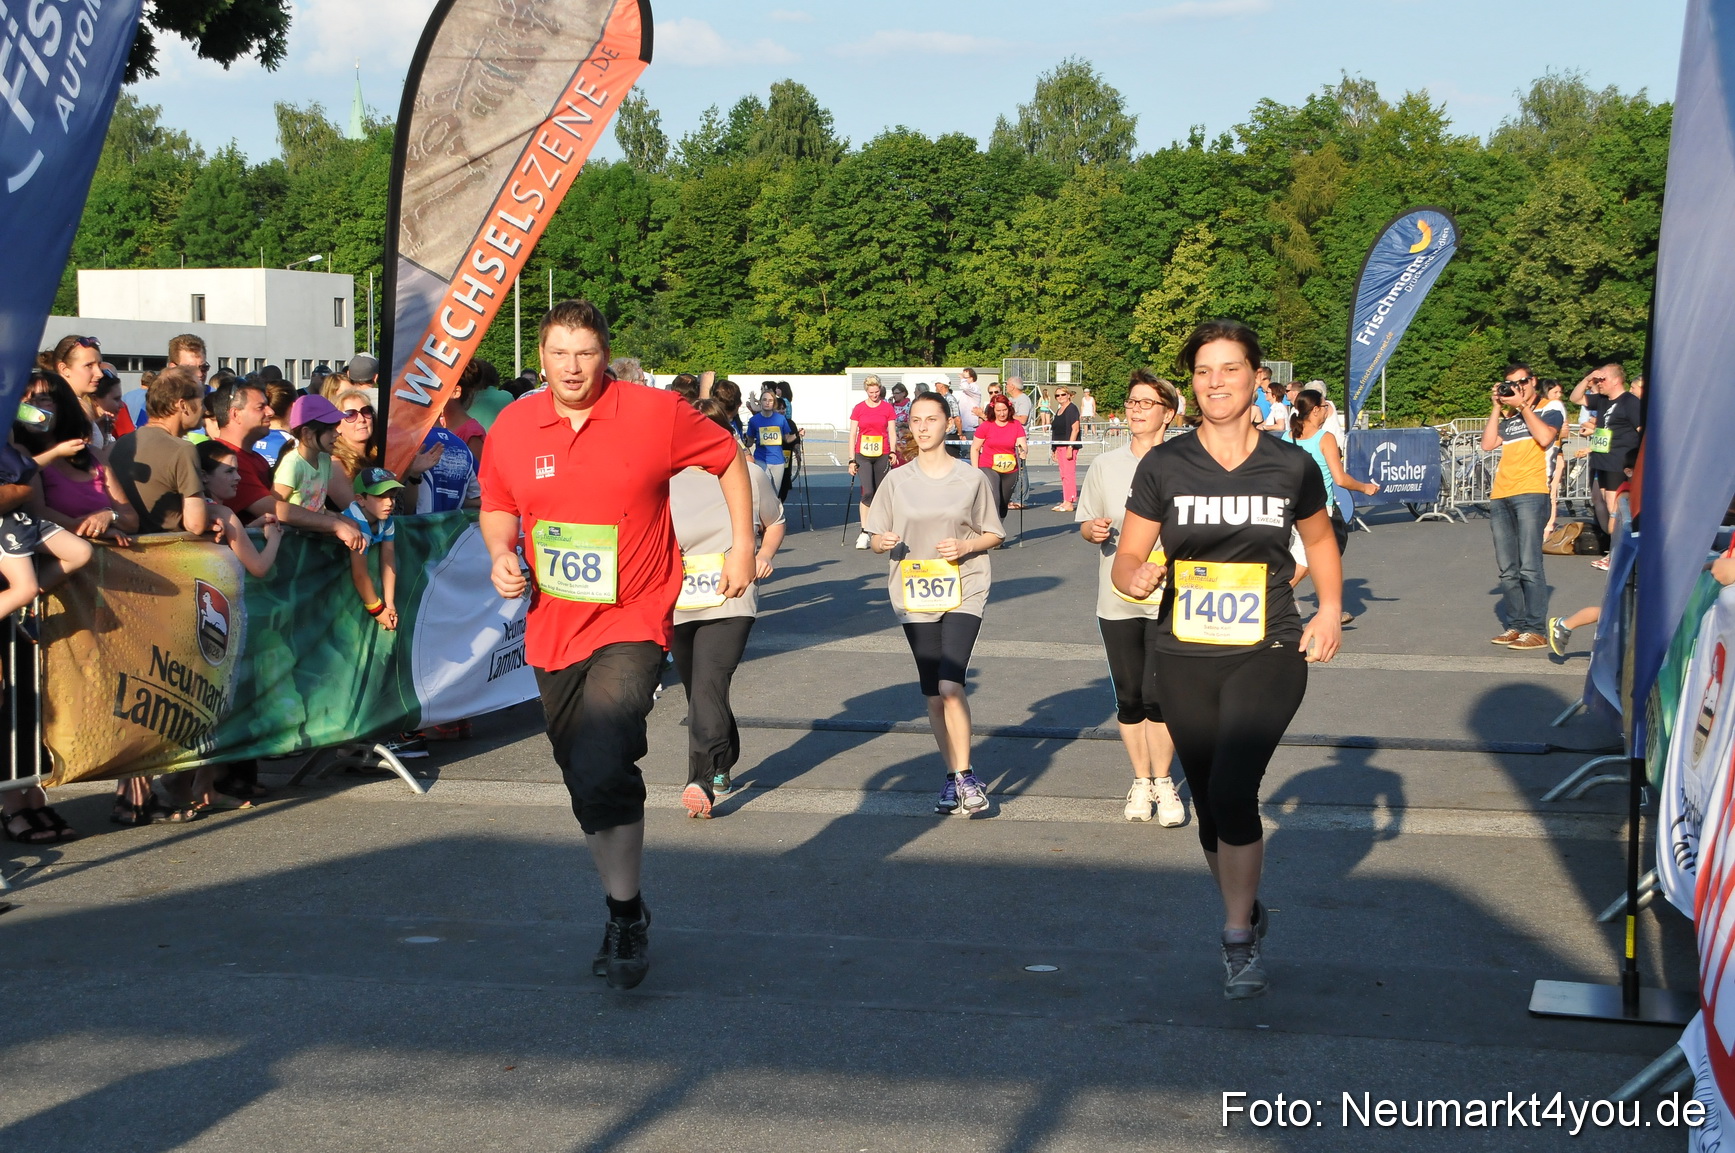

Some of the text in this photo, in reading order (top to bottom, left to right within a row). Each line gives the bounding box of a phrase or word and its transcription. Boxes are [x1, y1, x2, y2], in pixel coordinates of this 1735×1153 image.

[1355, 254, 1426, 346] Frischmann
[762, 432, 778, 441] 640
[863, 444, 880, 452] 418
[996, 461, 1013, 469] 417
[1380, 460, 1427, 481] Fischer
[1383, 483, 1423, 493] AUTOMOBILE
[1173, 495, 1285, 528] THULE
[1256, 516, 1281, 524] SWEDEN
[543, 548, 602, 583] 768
[905, 577, 956, 598] 1367
[1178, 590, 1260, 624] 1402
